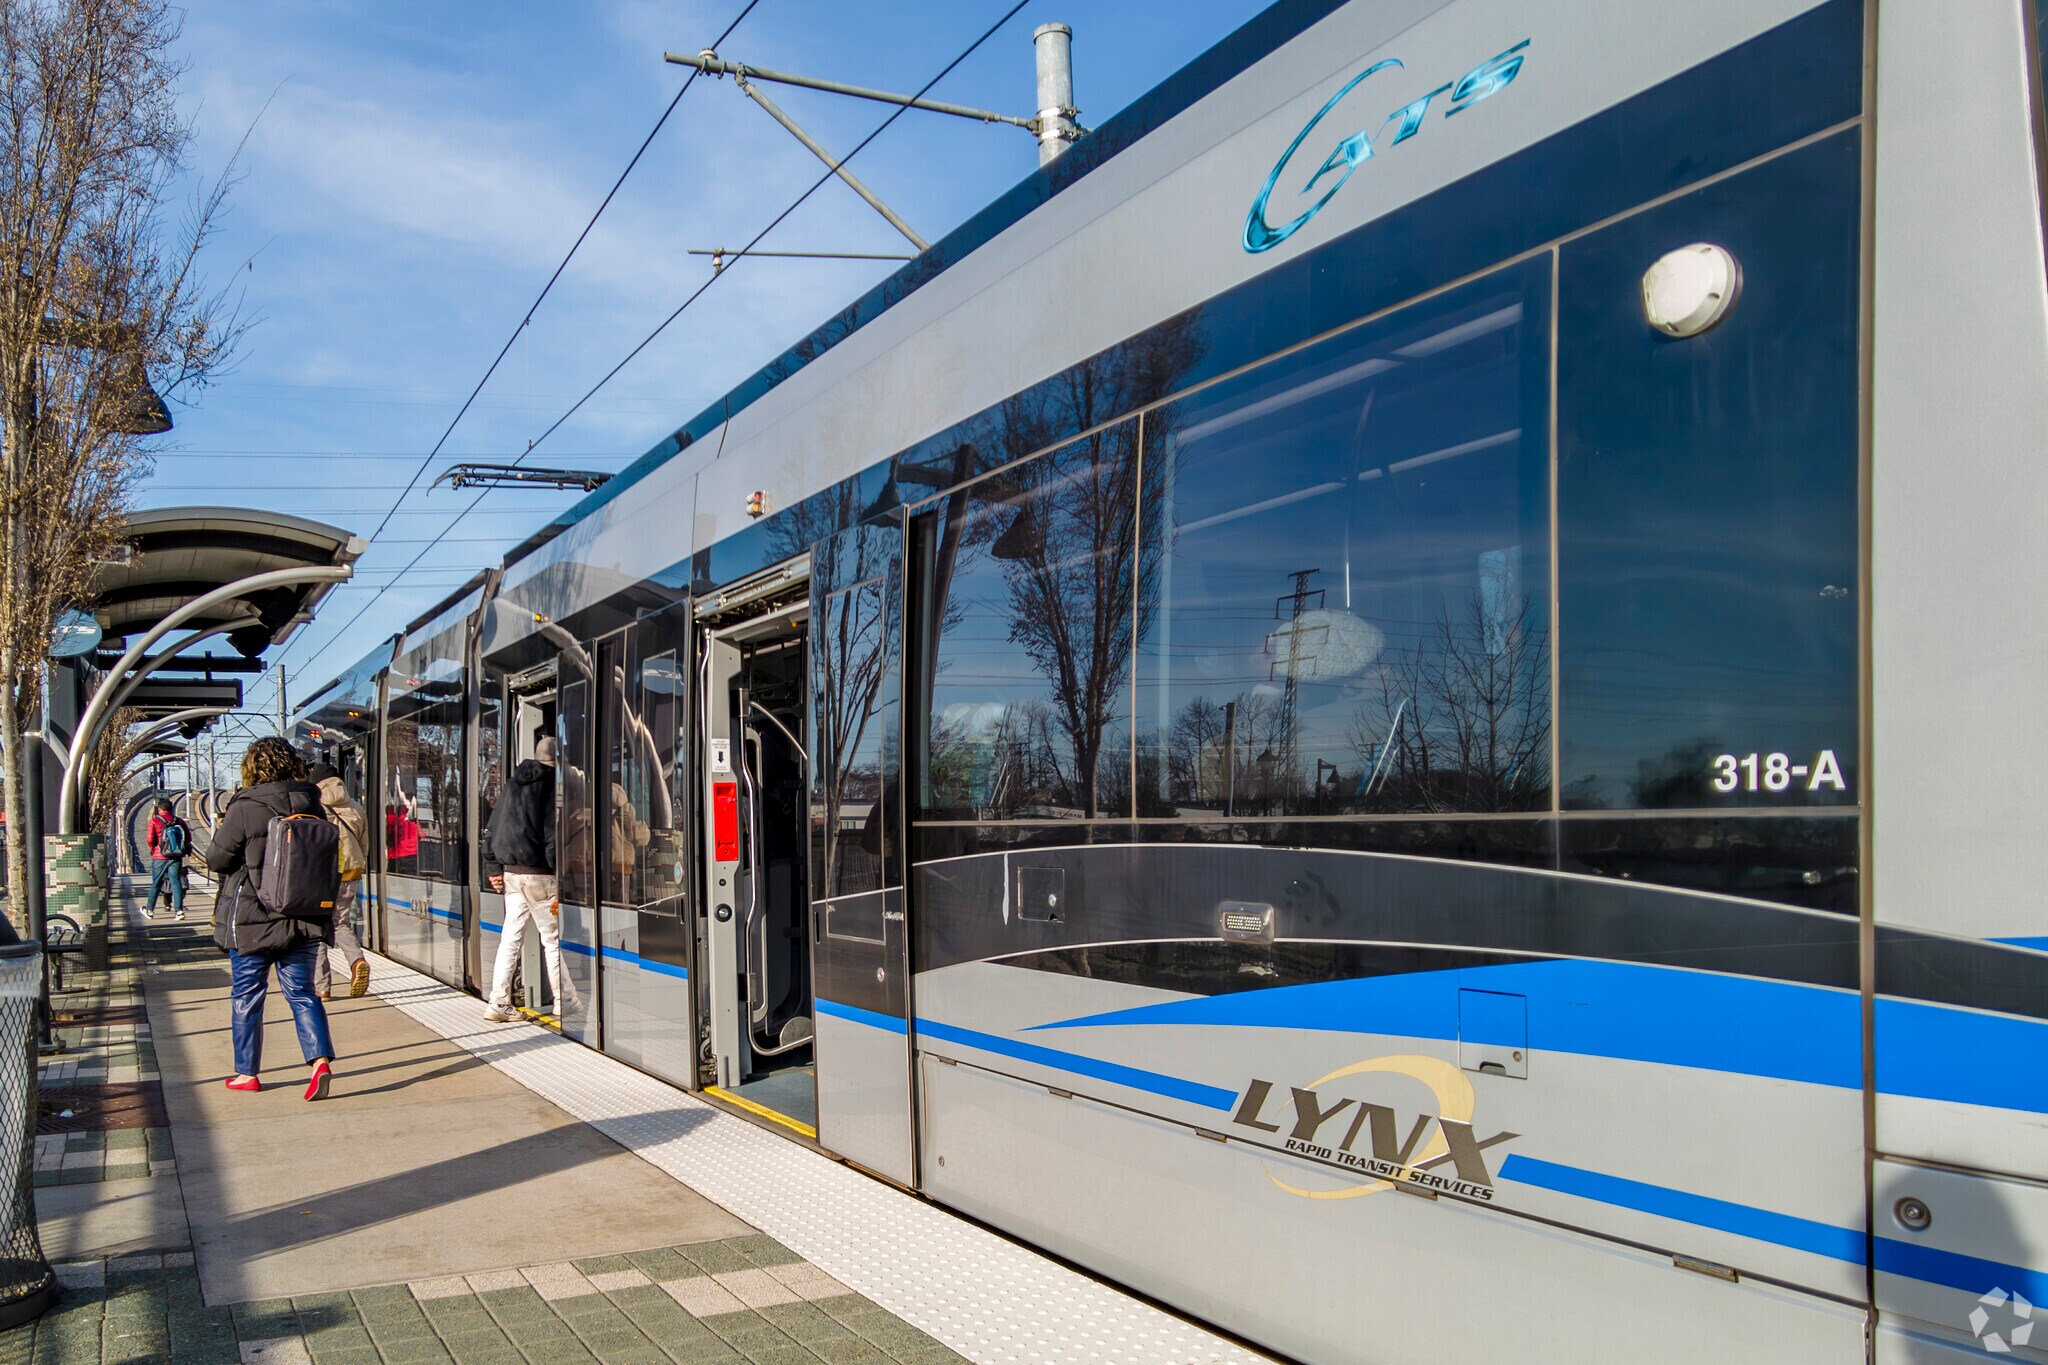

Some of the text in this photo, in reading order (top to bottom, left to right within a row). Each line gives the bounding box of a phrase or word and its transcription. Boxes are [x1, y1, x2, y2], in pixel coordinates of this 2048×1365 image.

[1242, 38, 1531, 254] CATS
[1713, 749, 1847, 793] 318-A
[1233, 1079, 1521, 1187] LYNX
[1285, 1138, 1494, 1200] RAPID TRANSIT SERVICES
